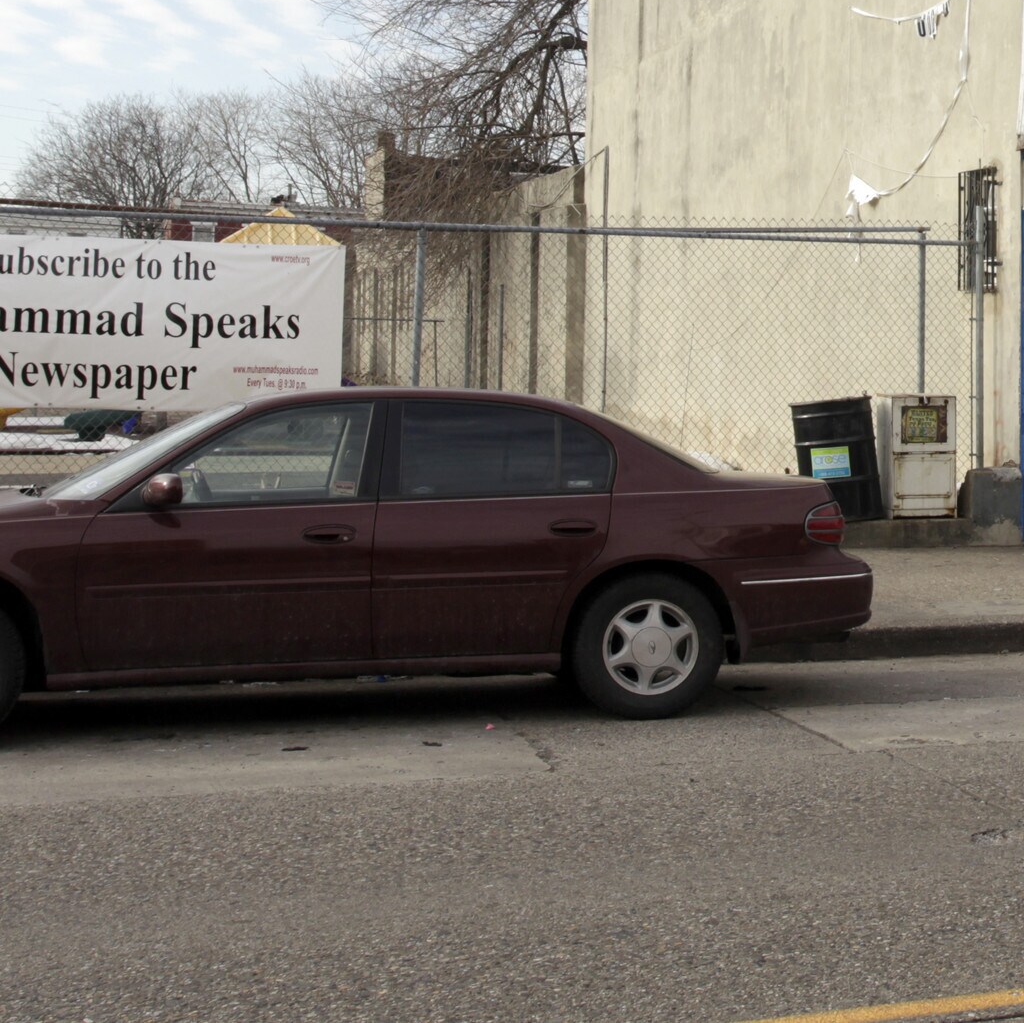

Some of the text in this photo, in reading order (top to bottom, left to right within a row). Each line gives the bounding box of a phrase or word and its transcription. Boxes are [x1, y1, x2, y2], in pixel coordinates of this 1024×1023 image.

[0, 246, 217, 282] ubscribe to the
[164, 301, 301, 349] Speaks
[233, 364, 319, 377] www.muhammadspeaksradio.com
[247, 378, 261, 389] Every
